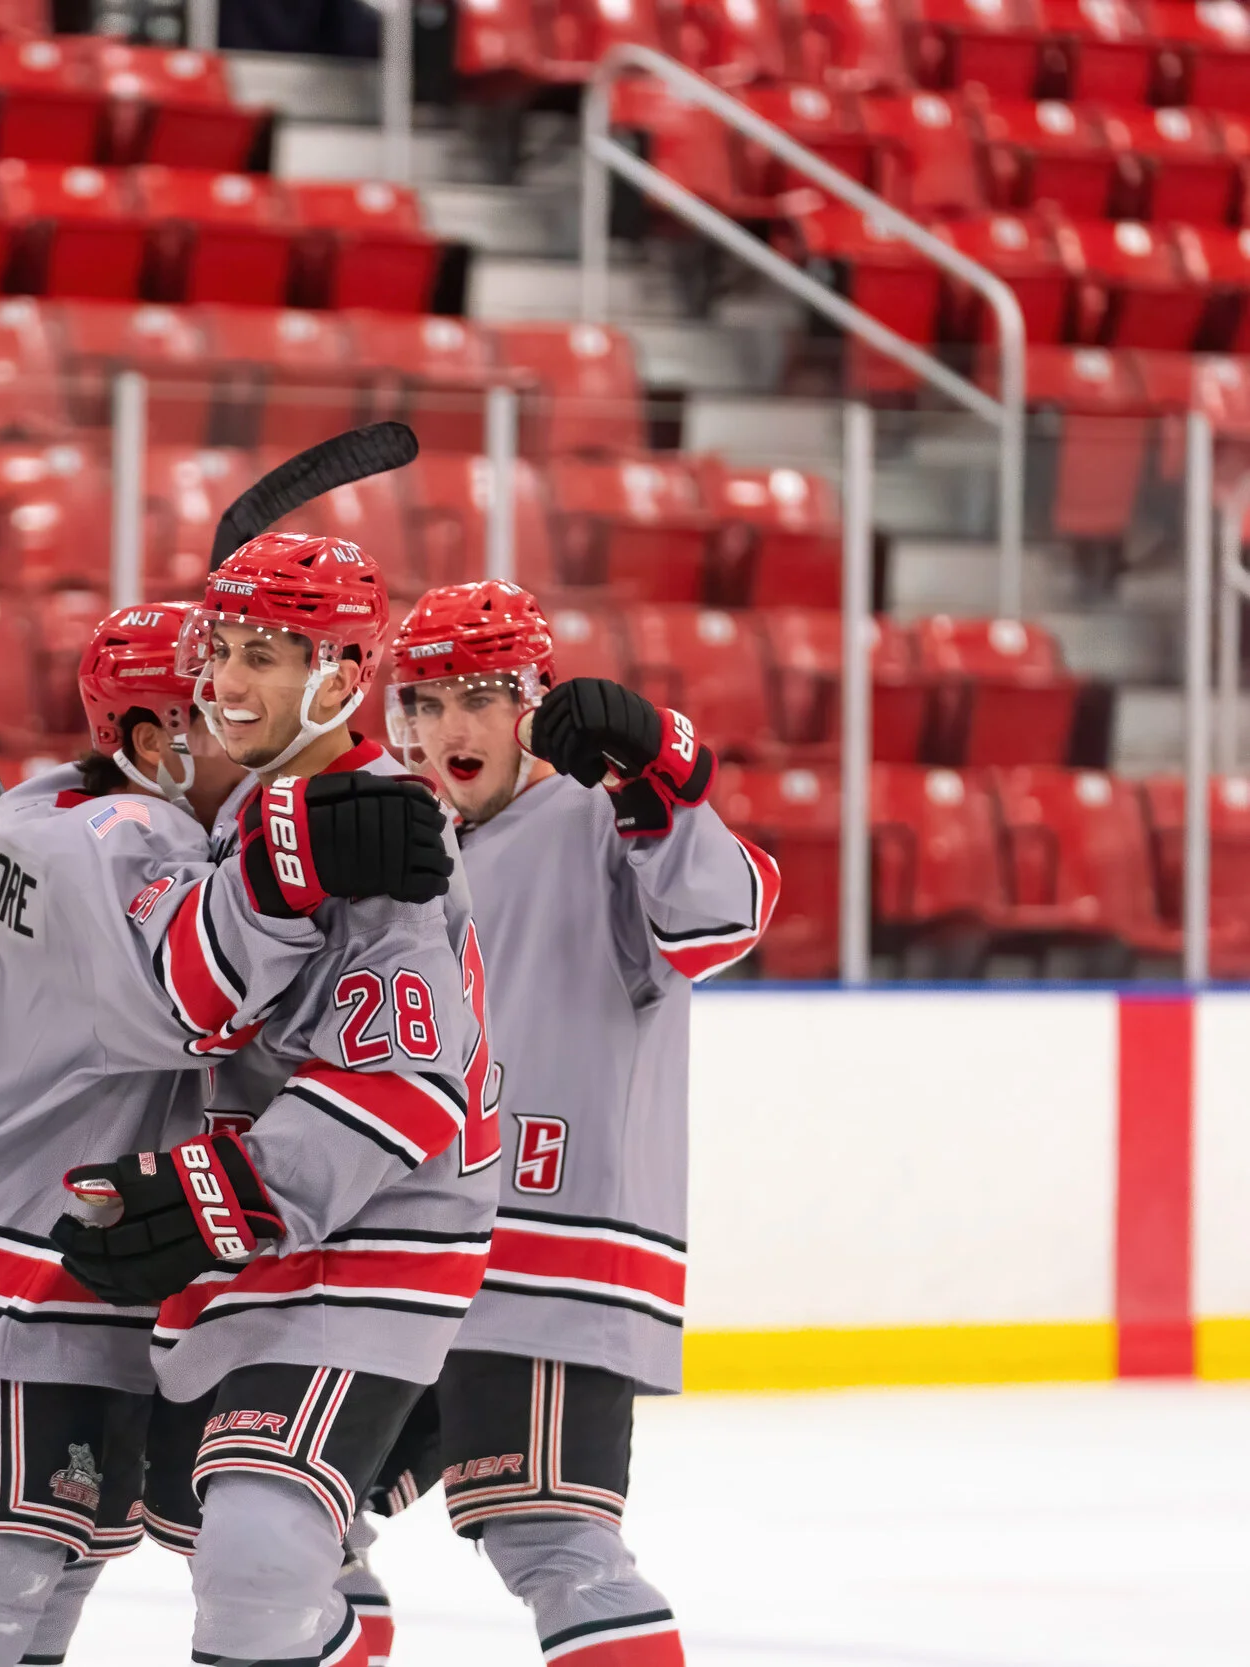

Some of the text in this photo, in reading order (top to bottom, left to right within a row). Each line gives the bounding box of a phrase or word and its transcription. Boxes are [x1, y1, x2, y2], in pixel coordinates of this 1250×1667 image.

[331, 546, 362, 563] NJT
[215, 578, 257, 596] TITANS
[124, 611, 164, 627] NJT
[408, 640, 454, 659] TITANS
[333, 966, 442, 1068] 28
[202, 1410, 288, 1441] AUER
[442, 1453, 524, 1488] AUER
